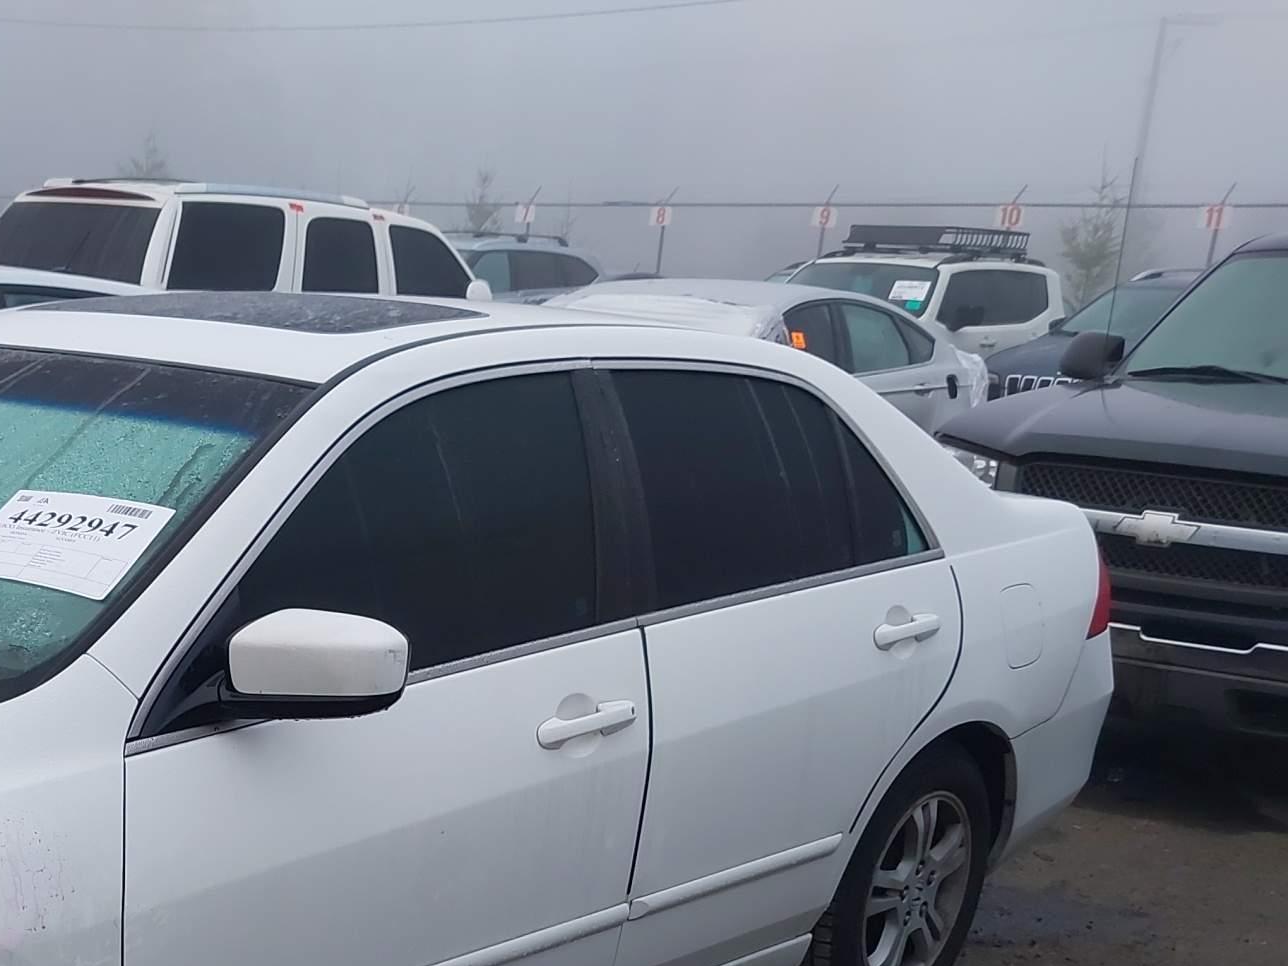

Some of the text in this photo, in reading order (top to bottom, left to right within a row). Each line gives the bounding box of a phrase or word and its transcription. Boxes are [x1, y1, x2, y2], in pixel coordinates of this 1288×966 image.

[655, 207, 666, 225] 8
[819, 206, 831, 226] 9
[999, 205, 1021, 227] 10
[1206, 207, 1224, 229] 11
[9, 509, 137, 540] 44292947
